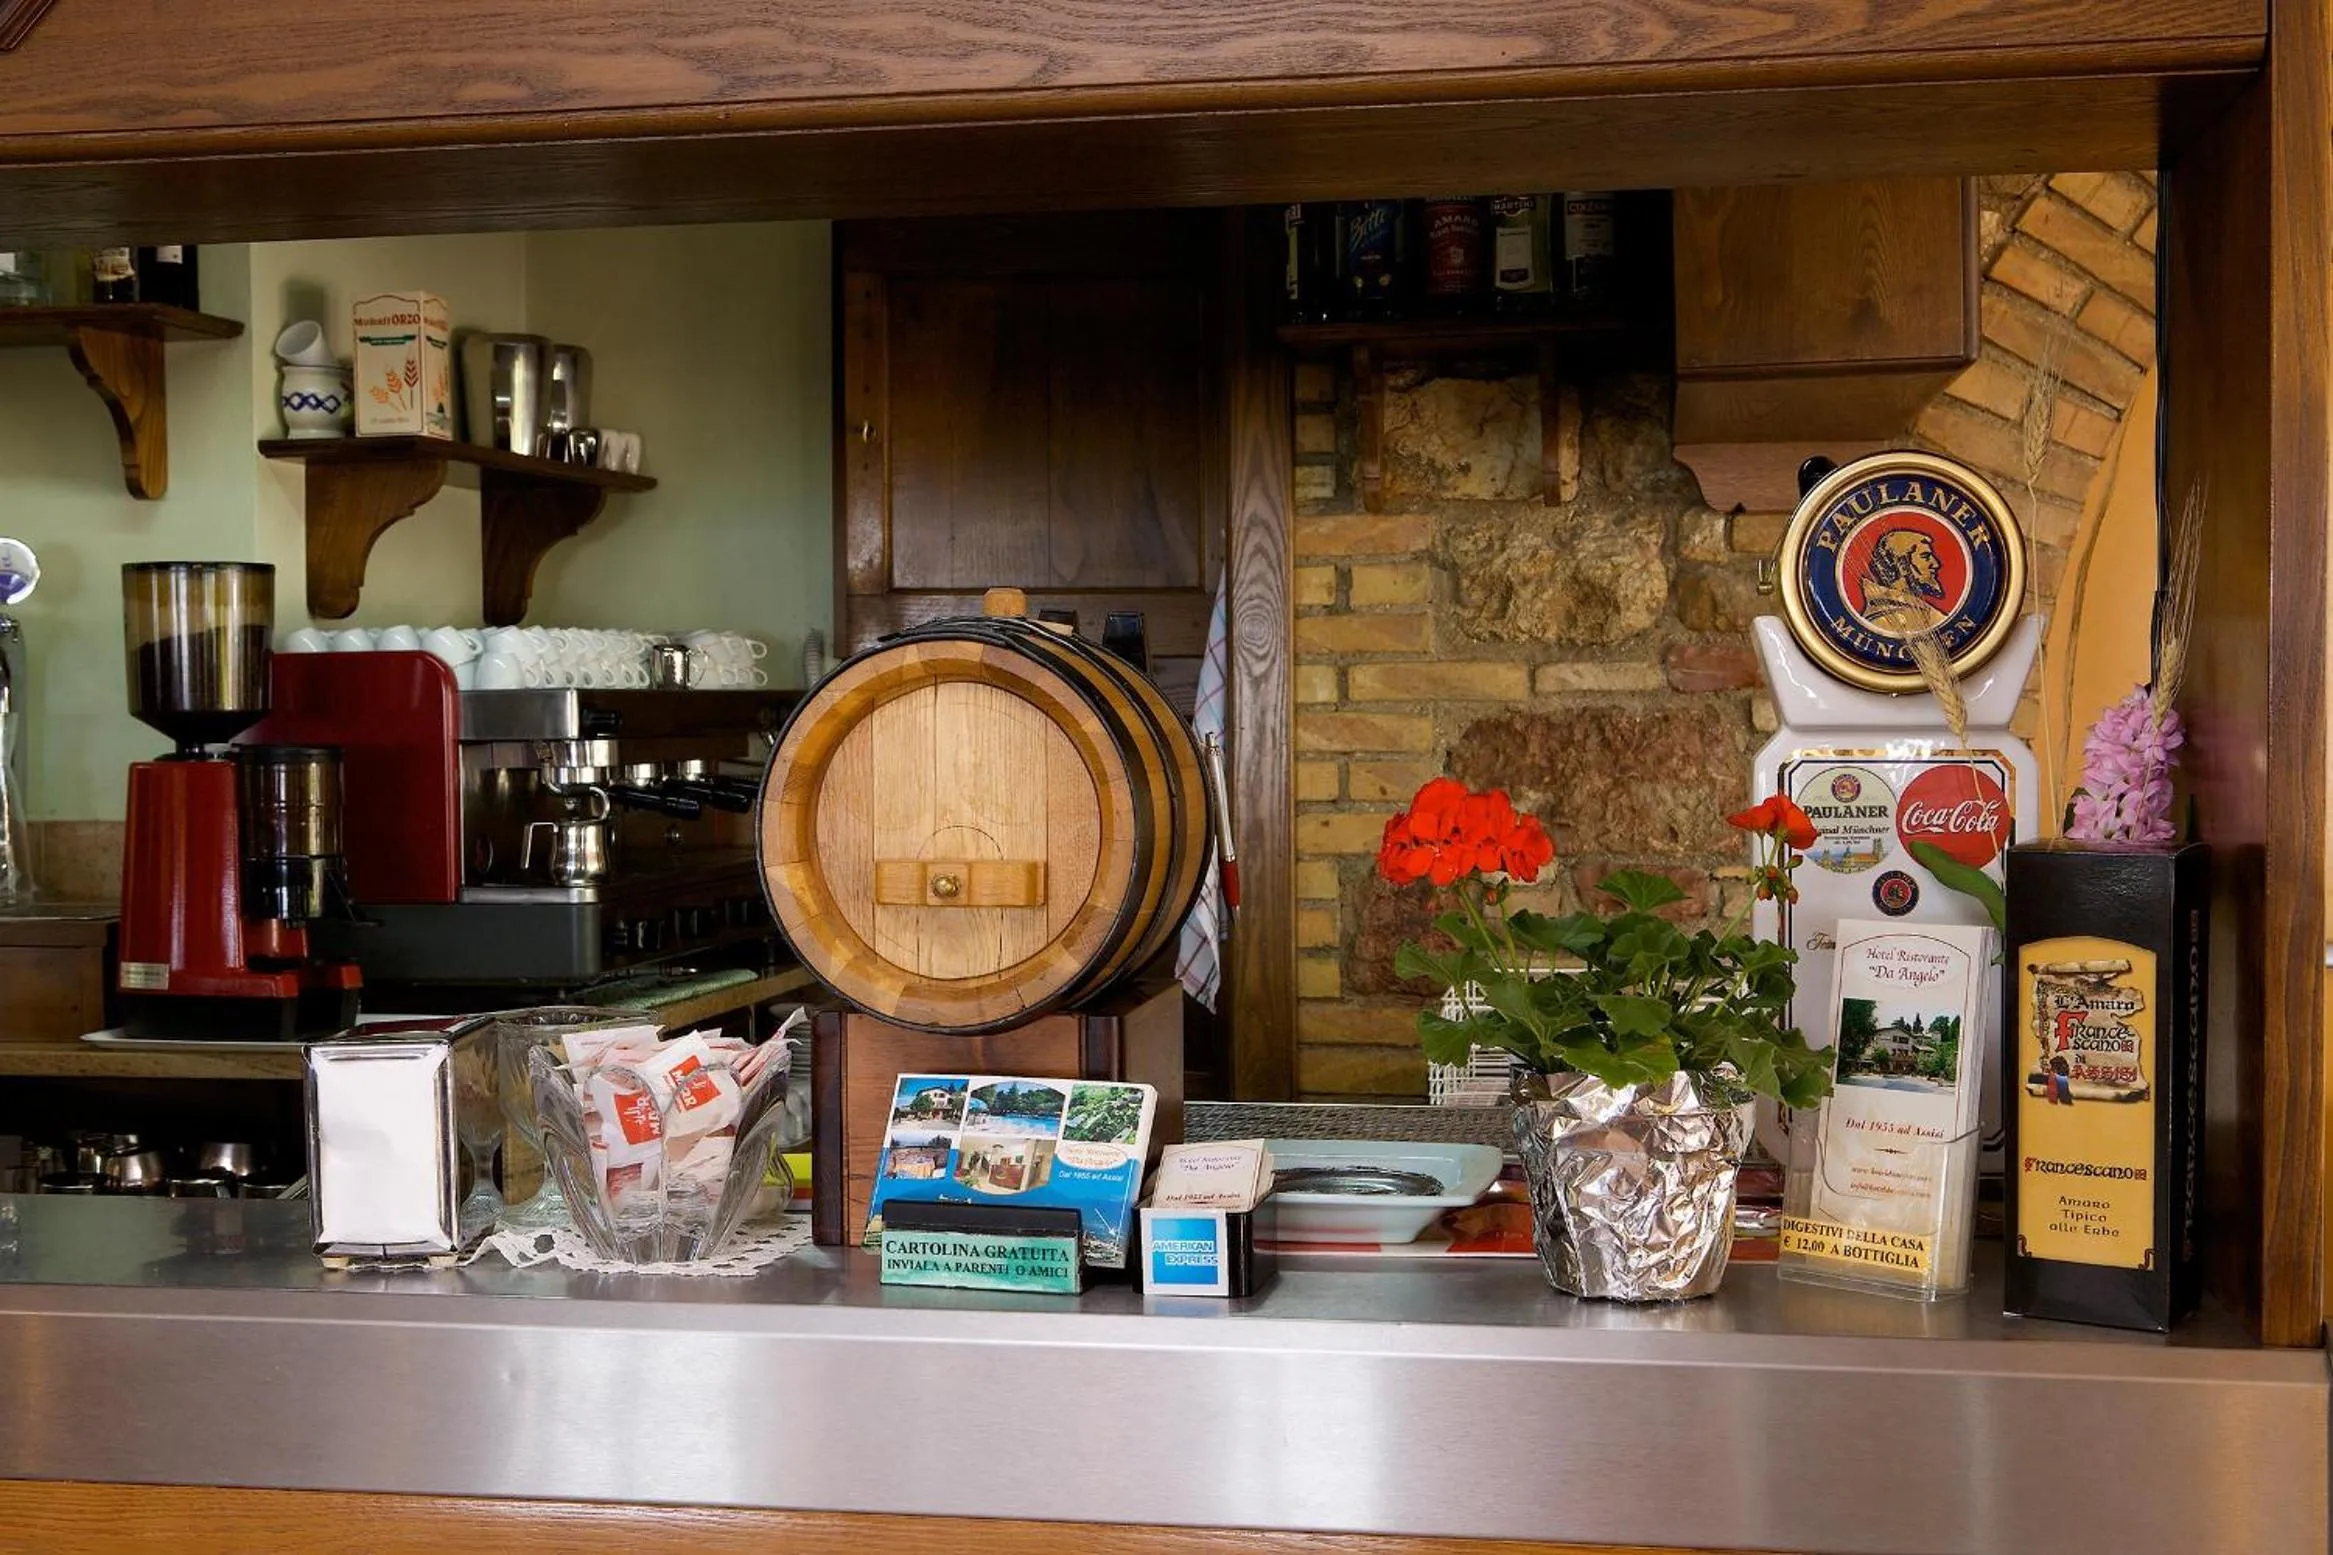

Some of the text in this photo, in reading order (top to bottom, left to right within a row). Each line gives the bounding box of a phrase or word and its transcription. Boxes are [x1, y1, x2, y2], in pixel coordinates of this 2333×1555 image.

[1433, 215, 1480, 228] AMARO
[1816, 481, 1992, 552] PAULANER
[1833, 614, 1977, 661] MÜNCEN
[1803, 805, 1889, 819] PAULANER
[1902, 800, 2001, 834] Coca-Cola
[1866, 946, 1950, 965] Hotel Ristorante
[2054, 995, 2135, 1010] L'Amaro
[1845, 1118, 1946, 1139] Dal 1955 ad Assisi
[2061, 1209, 2107, 1222] Tipico
[1783, 1218, 1925, 1252] DIGESTIVI DELLA CASA
[2083, 1225, 2120, 1238] Erbe
[885, 1240, 1070, 1262] CARTOLINA GRATUITA
[1153, 1241, 1212, 1251] AMERICAN
[1783, 1235, 1792, 1248] €
[1830, 1243, 1841, 1255] A
[1843, 1245, 1920, 1269] BOTTIGLIA
[887, 1258, 1068, 1278] INVIALA A PARENTI O AMICI
[1166, 1254, 1218, 1264] EXPRESS
